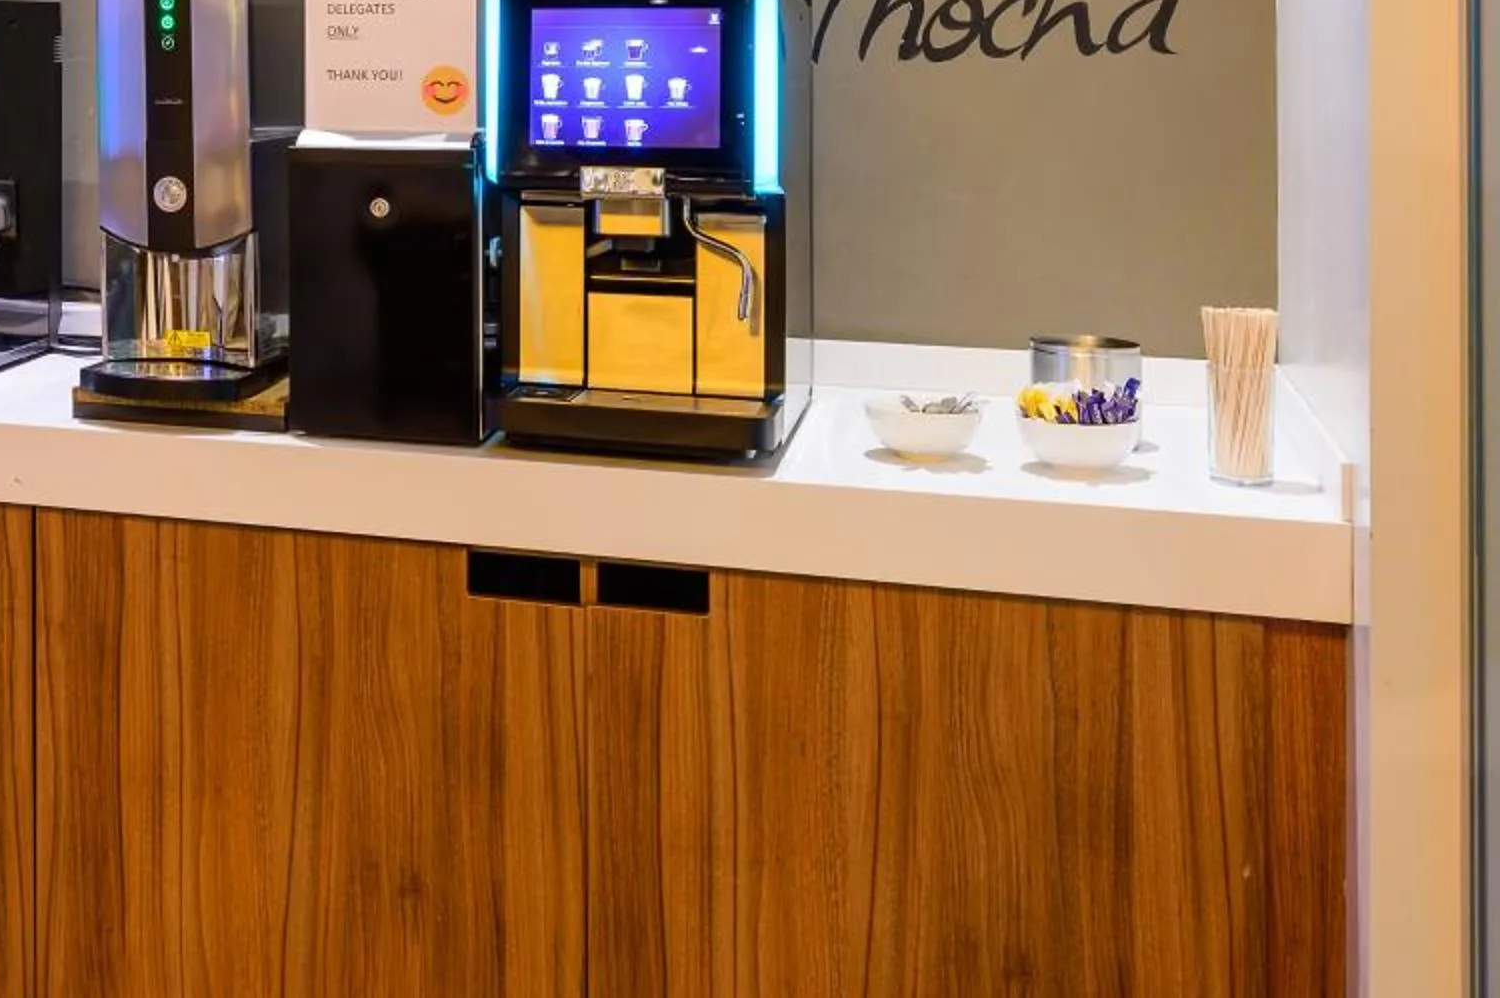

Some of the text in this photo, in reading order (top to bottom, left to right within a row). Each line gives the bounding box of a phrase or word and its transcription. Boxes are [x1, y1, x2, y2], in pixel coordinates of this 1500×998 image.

[326, 3, 396, 16] DELEGATES
[326, 25, 360, 38] ONLY
[327, 68, 404, 82] THANK YOU!
